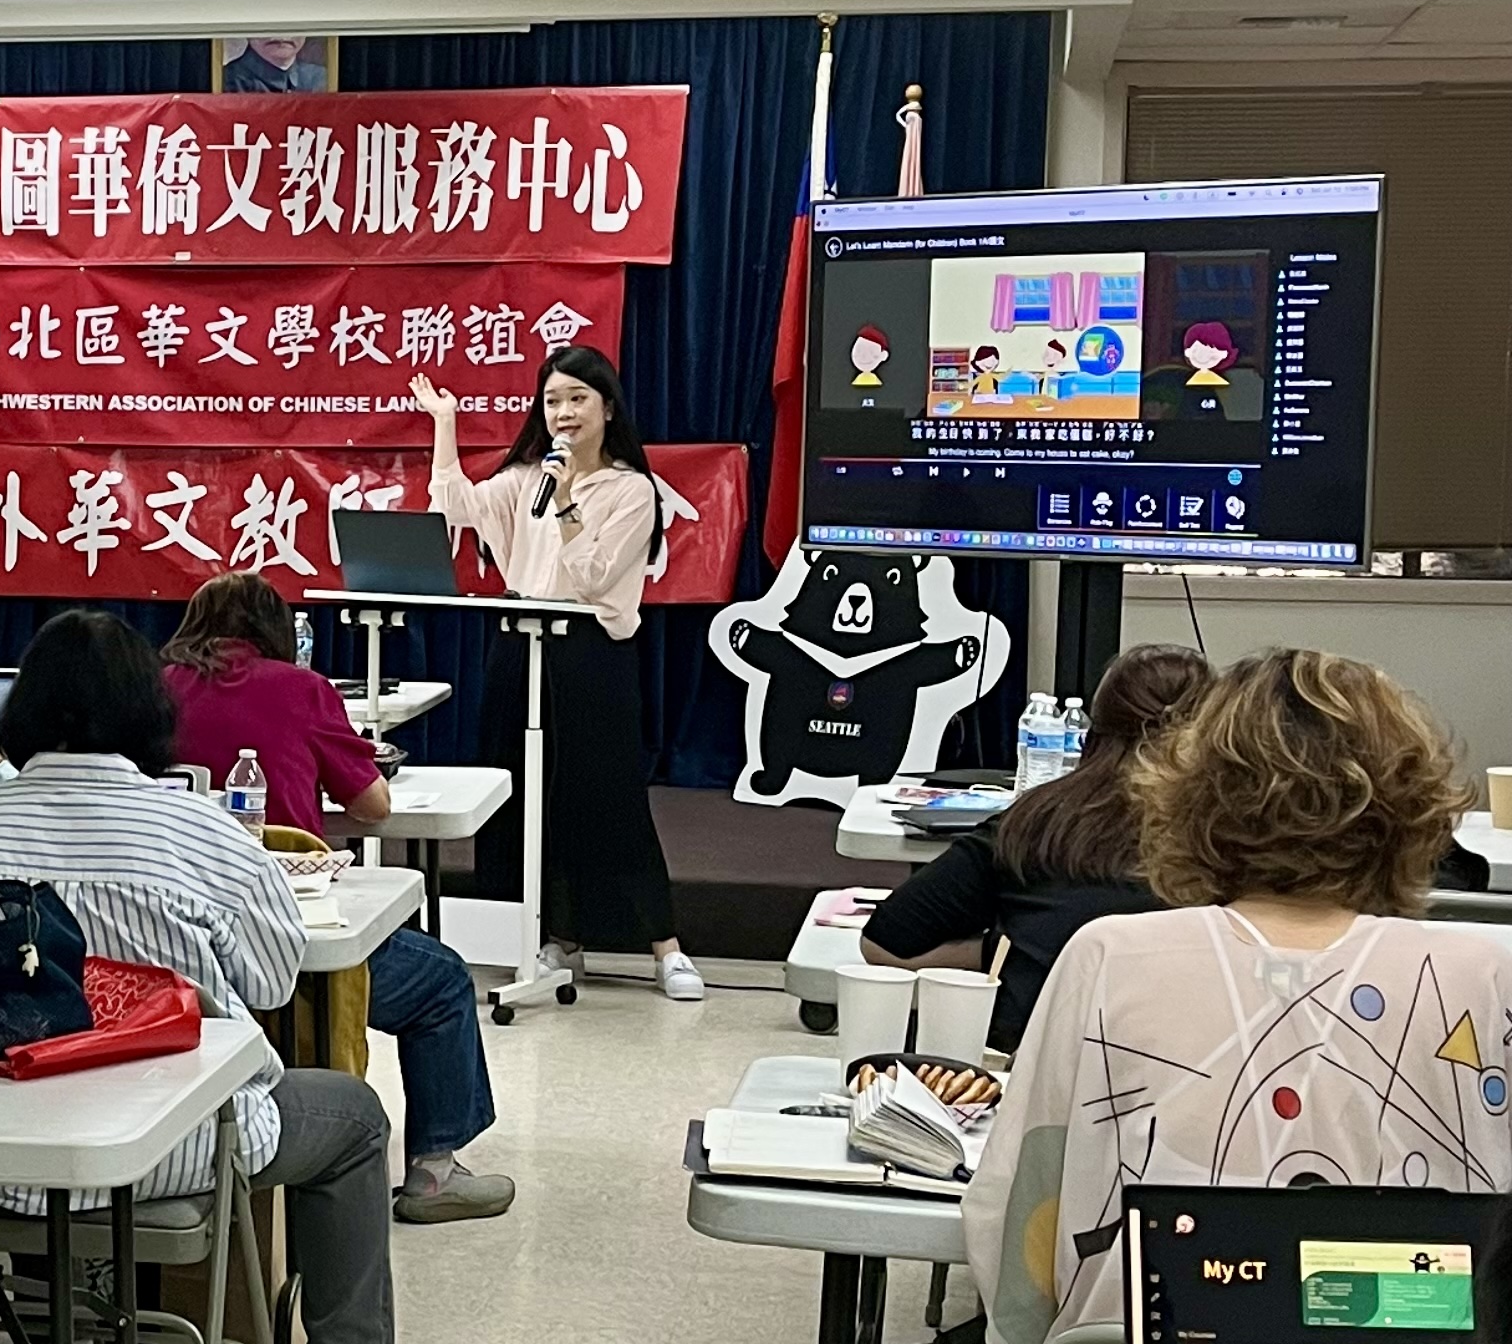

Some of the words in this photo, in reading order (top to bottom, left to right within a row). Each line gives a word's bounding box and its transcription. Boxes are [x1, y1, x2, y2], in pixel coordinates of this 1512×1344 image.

[107, 394, 243, 413] ASSOCIATION
[247, 395, 276, 413] OF
[279, 396, 370, 413] CHINESE
[375, 396, 489, 413] LANGE
[807, 719, 862, 737] SEATTLE
[1203, 1259, 1234, 1284] My
[1238, 1260, 1267, 1281] CT
